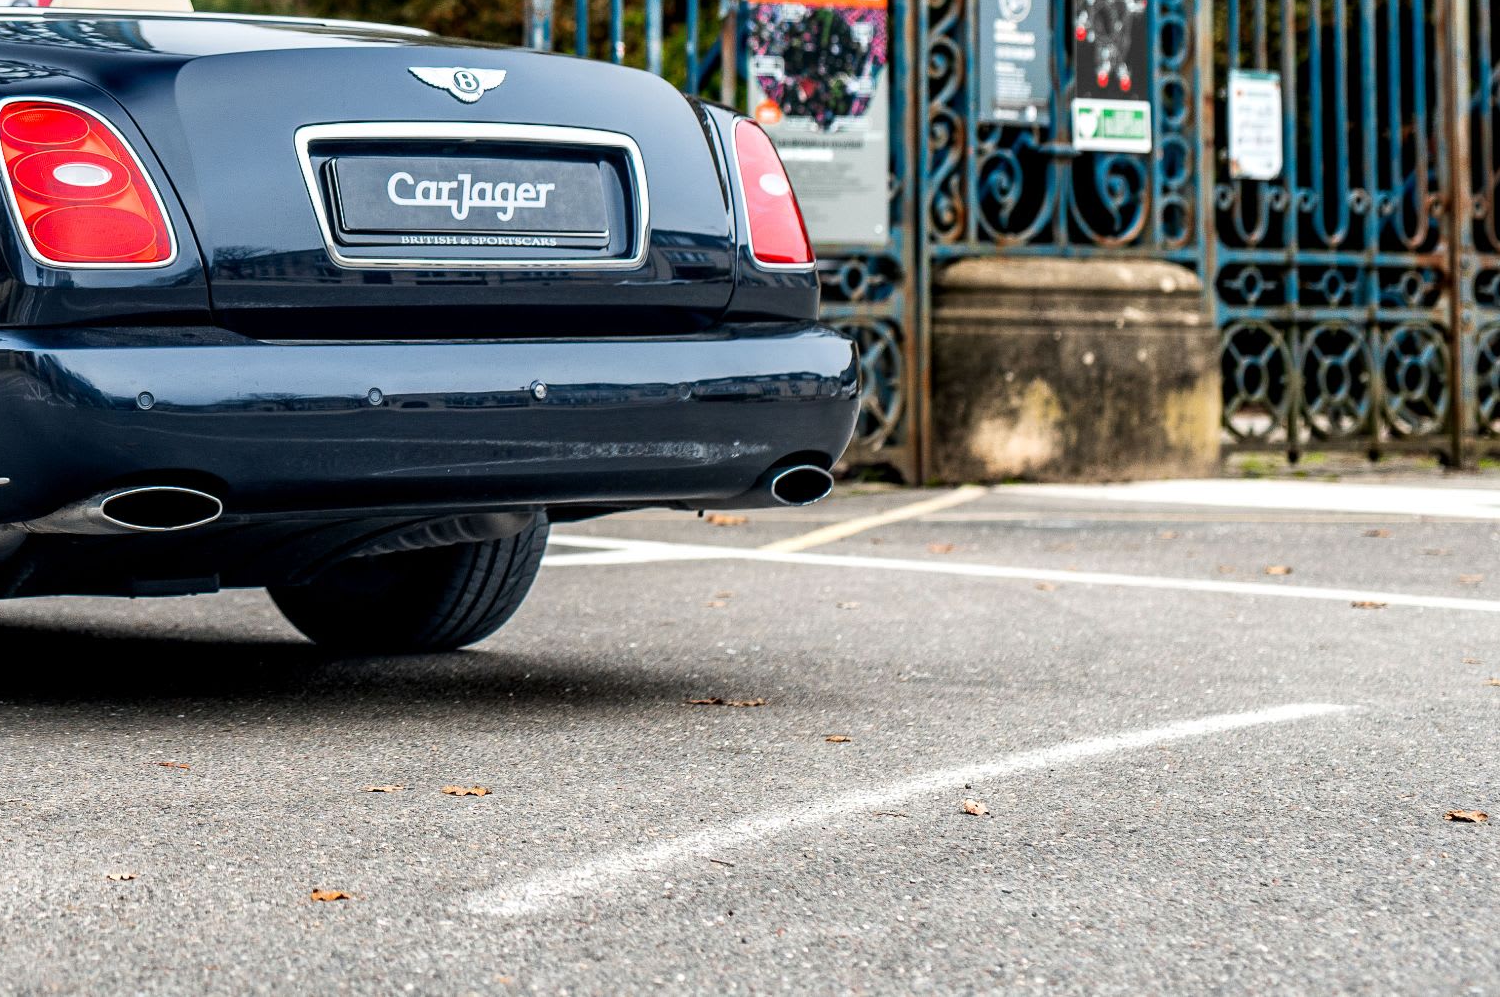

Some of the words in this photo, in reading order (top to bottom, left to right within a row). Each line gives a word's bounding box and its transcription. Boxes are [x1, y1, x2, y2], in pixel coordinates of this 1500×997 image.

[455, 70, 477, 90] B
[387, 171, 555, 221] CarJager
[401, 235, 457, 245] BRITISH
[460, 237, 470, 245] &
[471, 237, 557, 247] SPORTSCARS
